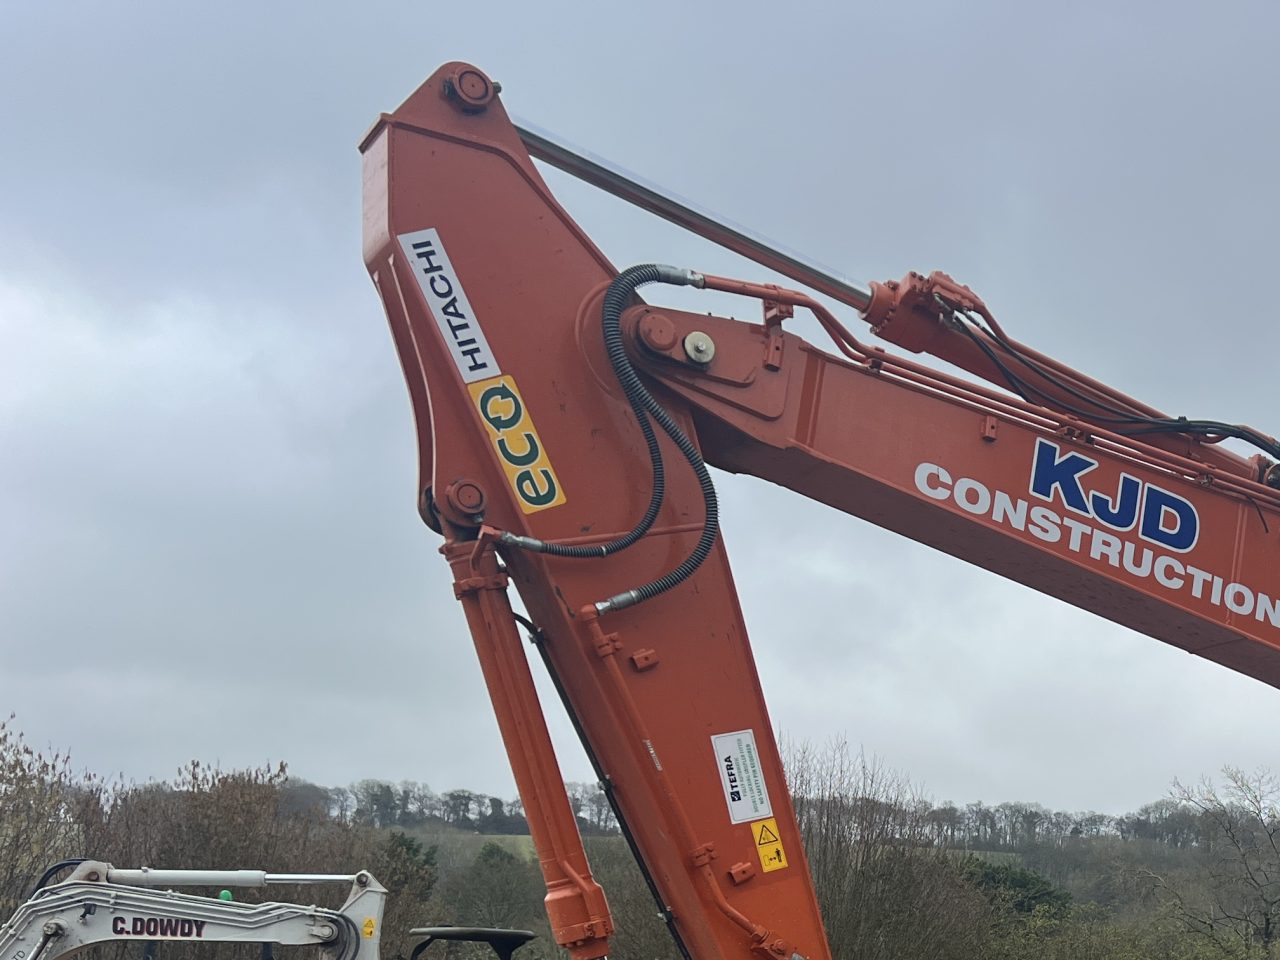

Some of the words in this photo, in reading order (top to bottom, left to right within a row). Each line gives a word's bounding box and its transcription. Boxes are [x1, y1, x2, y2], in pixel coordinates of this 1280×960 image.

[412, 240, 487, 372] HITACHI
[1029, 437, 1200, 554] KJD
[724, 755, 738, 790] TEFRA
[753, 778, 763, 796] SAFETY
[112, 916, 207, 938] C.DOWDY
